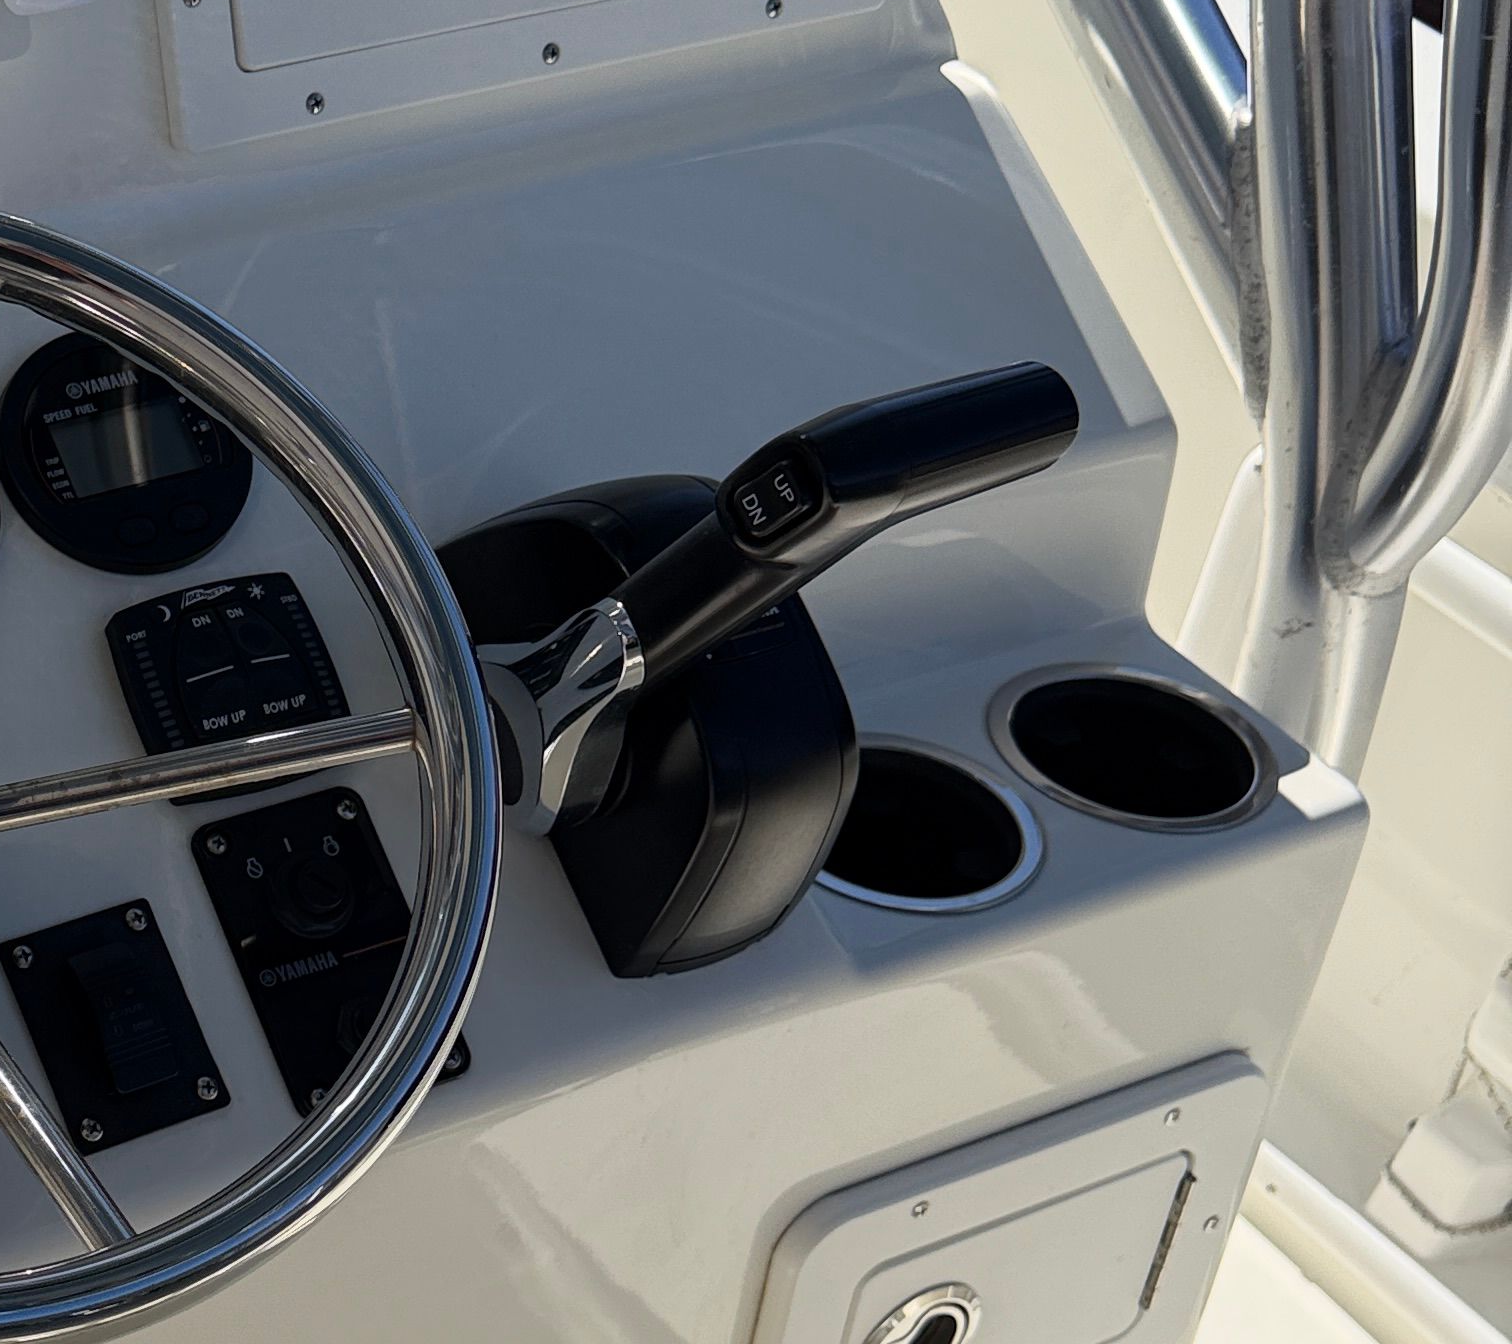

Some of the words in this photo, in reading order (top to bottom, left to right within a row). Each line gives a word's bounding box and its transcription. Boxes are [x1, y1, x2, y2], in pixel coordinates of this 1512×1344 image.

[80, 369, 139, 396] YAMAHA
[43, 409, 73, 424] SPEED
[74, 402, 98, 416] FUEL
[774, 474, 796, 503] UP
[742, 493, 767, 526] DN
[192, 613, 212, 629] DN
[224, 606, 245, 620] DN
[125, 629, 147, 643] PORT
[262, 697, 289, 715] BOW
[290, 693, 307, 708] UP
[201, 713, 229, 731] BOW
[230, 709, 247, 724] UP
[275, 950, 339, 982] YAMAHA
